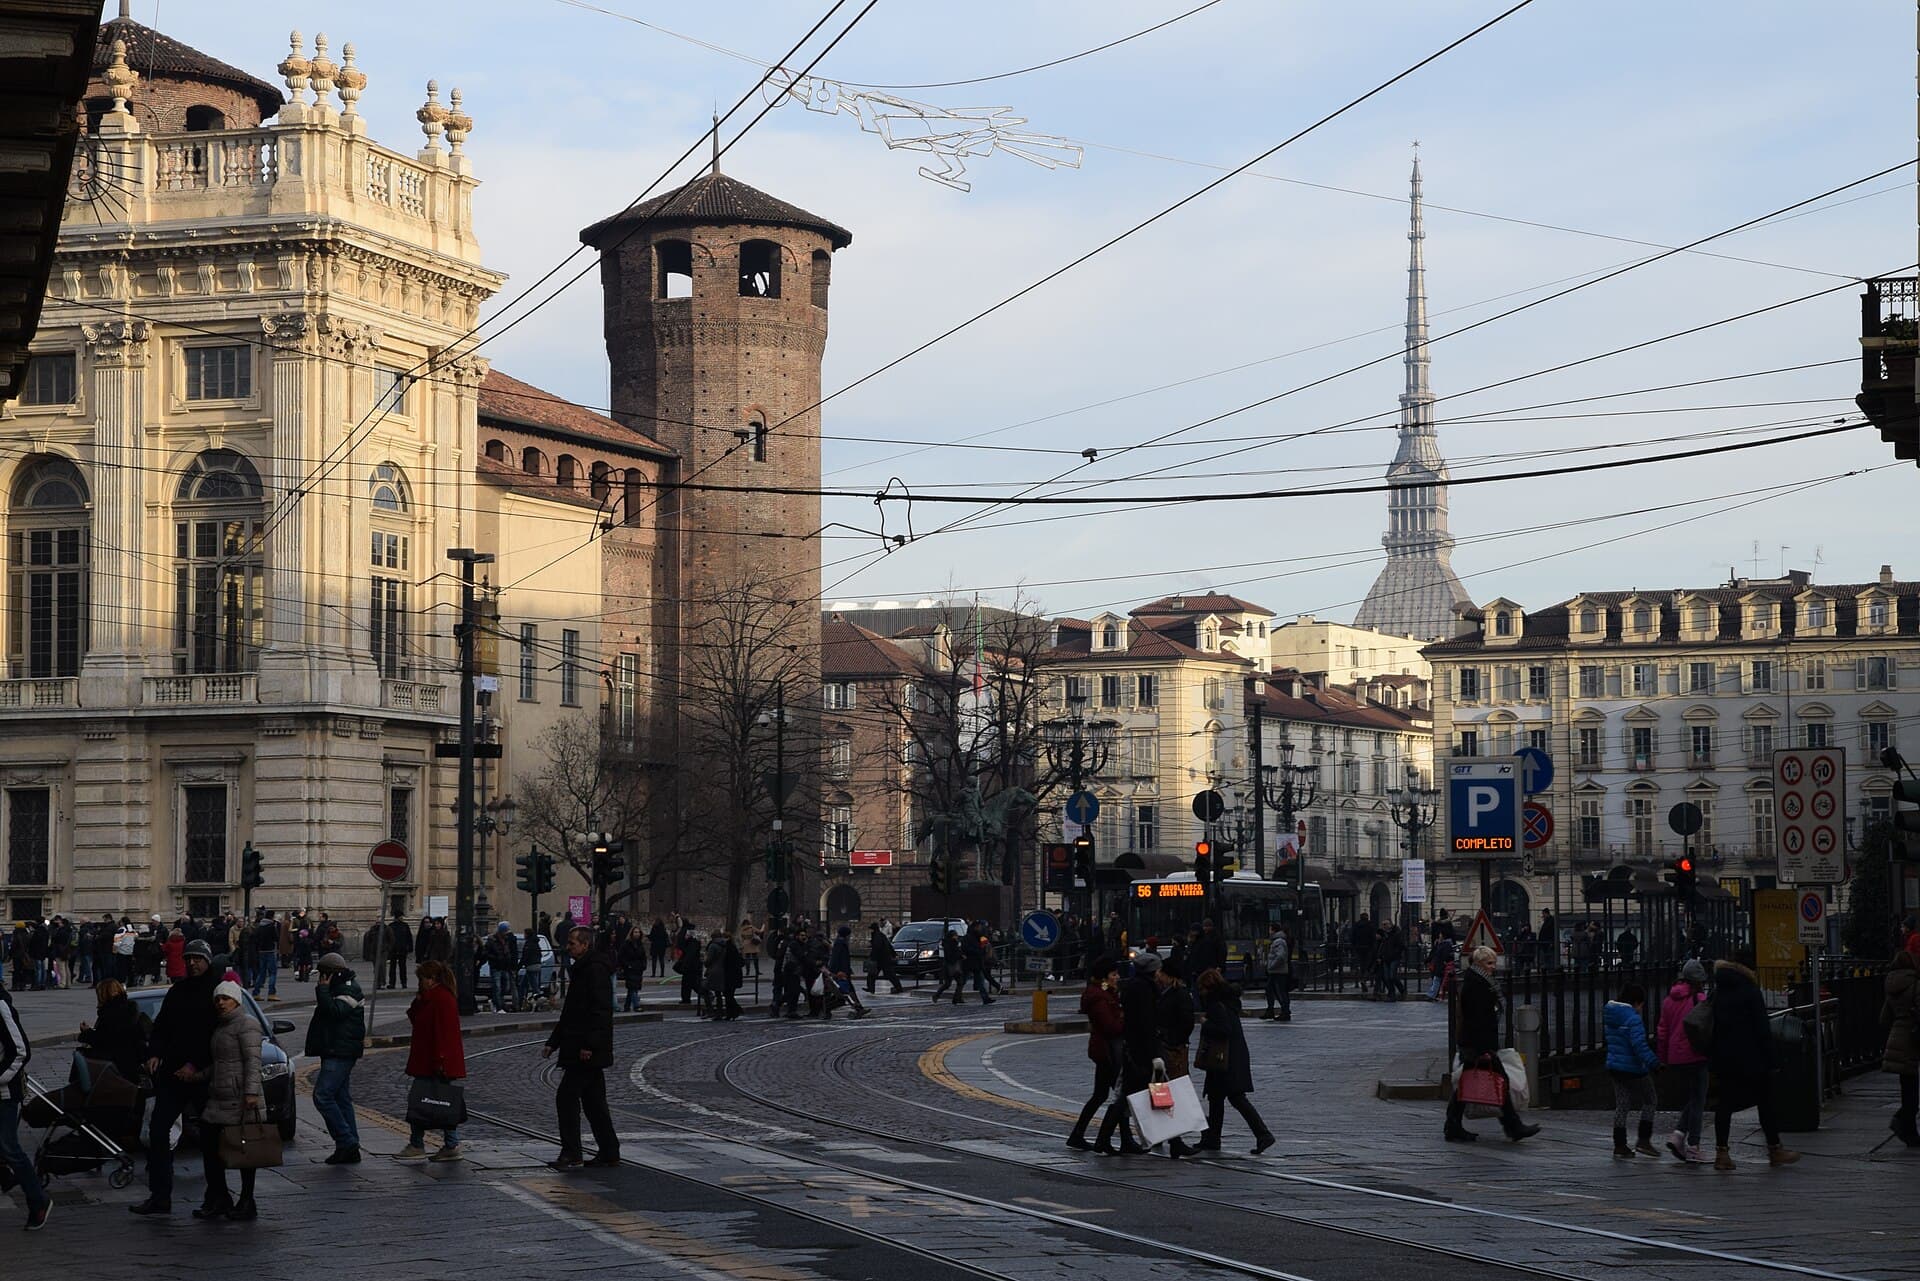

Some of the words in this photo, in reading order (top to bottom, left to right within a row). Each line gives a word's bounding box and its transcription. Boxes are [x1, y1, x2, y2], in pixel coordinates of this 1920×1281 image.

[1454, 765, 1473, 774] GTT
[1467, 785, 1501, 828] P
[1456, 837, 1512, 850] COMPLETO
[1137, 885, 1152, 898] 56
